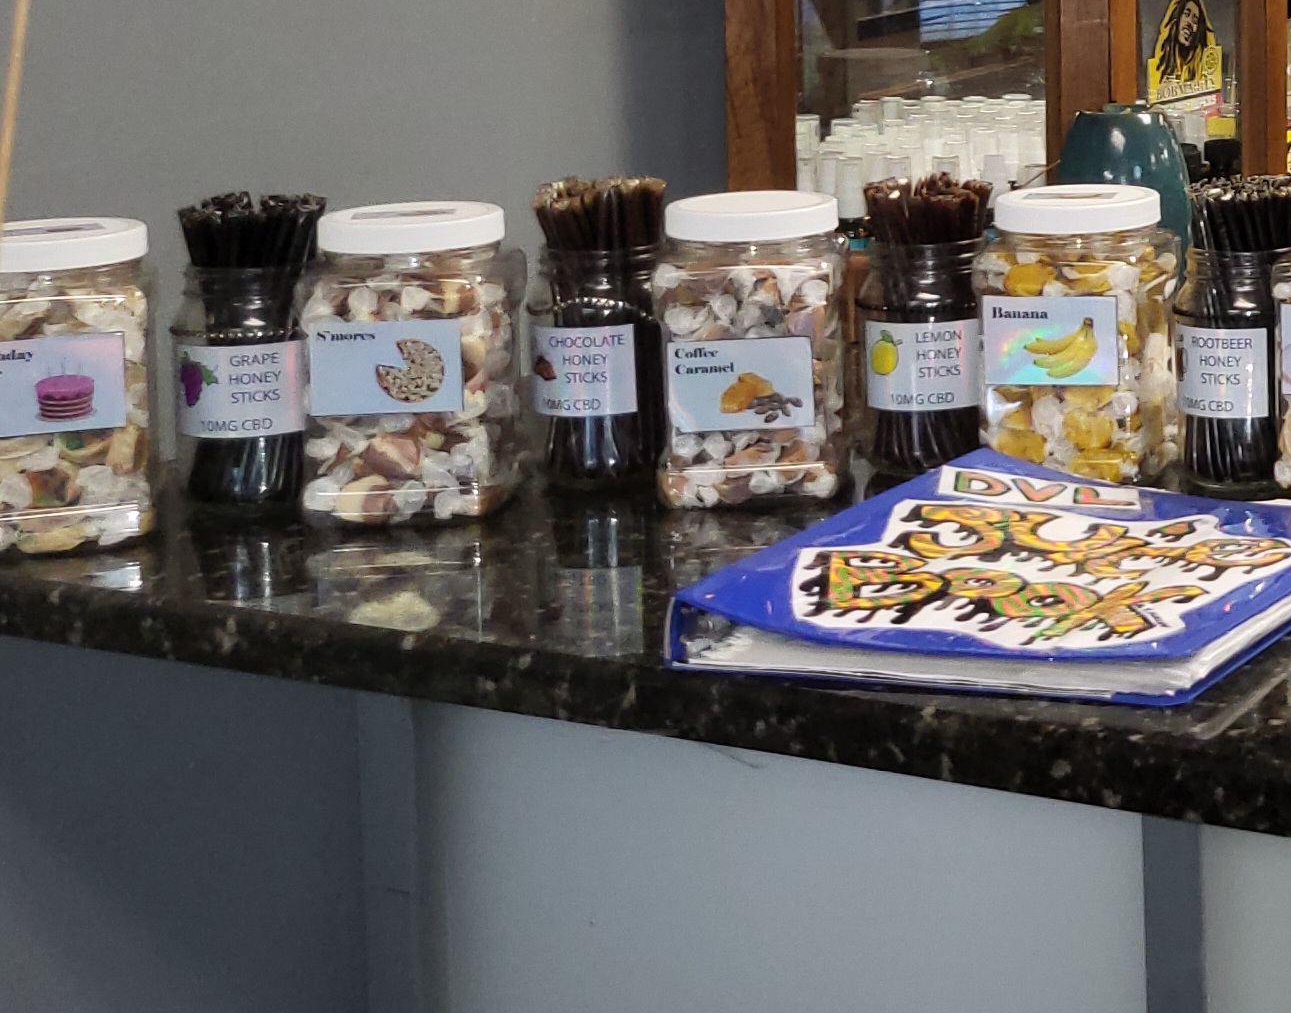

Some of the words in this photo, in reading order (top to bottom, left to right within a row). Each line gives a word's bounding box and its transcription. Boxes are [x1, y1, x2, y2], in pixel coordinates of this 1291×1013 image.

[991, 306, 1049, 321] Banana
[317, 329, 375, 342] S'mores
[550, 334, 626, 348] CHOCOLATE
[915, 330, 963, 344] LEMON
[1192, 336, 1253, 351] ROOTBEER
[229, 352, 280, 367] GRAPE
[562, 353, 609, 367] HONEY
[674, 347, 719, 360] Coffee
[916, 347, 962, 361] HONEY
[1199, 354, 1242, 368] HONEY
[674, 362, 735, 376] Caramel
[917, 364, 962, 377] STICKS
[229, 370, 282, 385] HONEY
[563, 371, 609, 384] STICKS
[1200, 371, 1241, 386] STICKS
[231, 389, 282, 404] STICKS
[927, 391, 955, 405] CBD
[573, 397, 602, 411] CBD
[1208, 398, 1234, 412] CBD
[241, 417, 274, 431] CBD
[953, 470, 1139, 506] DVL
